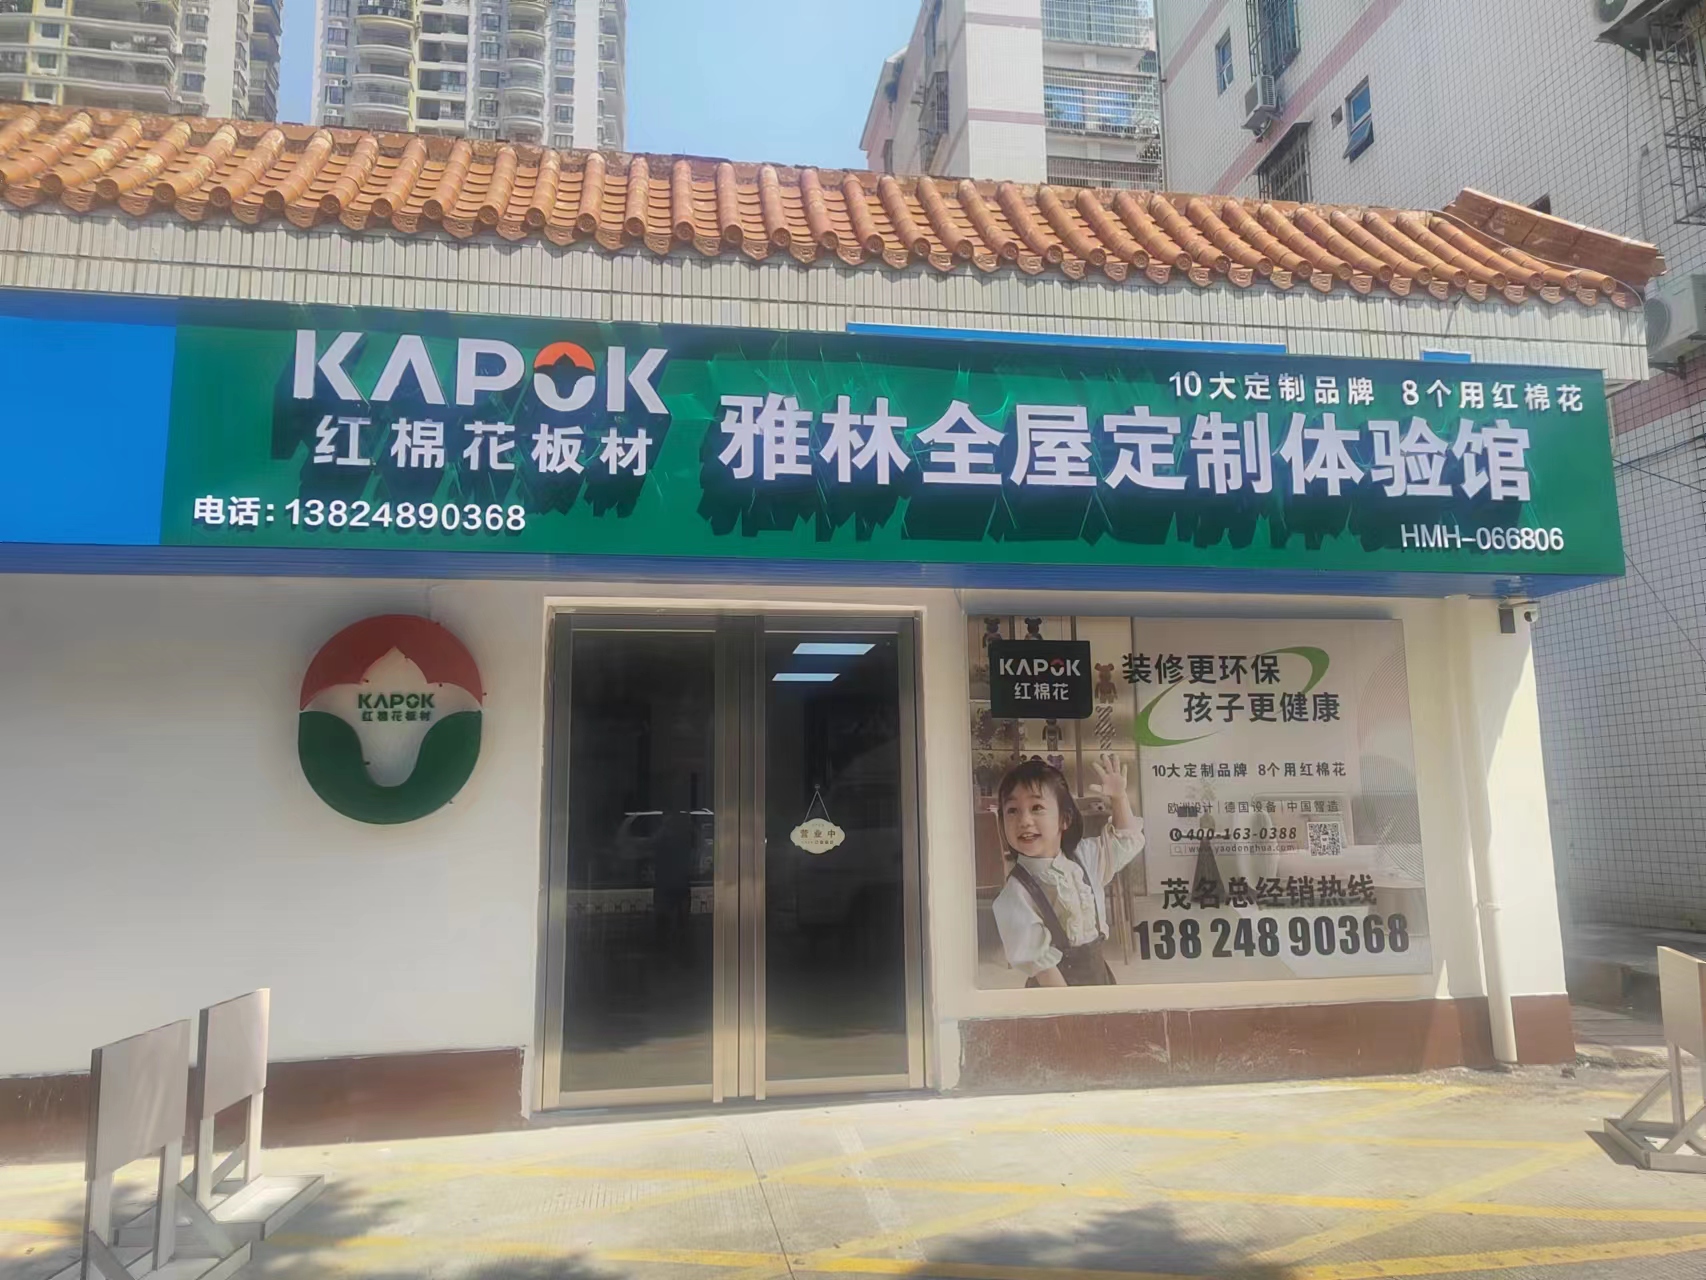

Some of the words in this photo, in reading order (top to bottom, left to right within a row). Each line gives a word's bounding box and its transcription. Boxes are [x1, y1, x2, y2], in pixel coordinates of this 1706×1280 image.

[293, 328, 671, 415] KAPOK
[1169, 370, 1375, 406] 10大定制品牌
[1402, 378, 1584, 412] 8个用红棉花
[313, 414, 653, 476] 红棉花板材
[717, 391, 1531, 502] 雅林全屋定制体验馆
[1401, 523, 1565, 552] HMH-066806
[999, 657, 1081, 677] KAPOK
[1121, 652, 1281, 685] 装修更环保
[357, 693, 435, 709] KAPOK
[1014, 682, 1069, 700] 红棉花
[1182, 691, 1341, 723] 孩子更健康
[1151, 763, 1248, 778] 10大定制品牌
[1258, 762, 1346, 777] 8个用红棉花
[1186, 827, 1297, 841] 400-163-0388
[1188, 844, 1295, 855] wwyaodonghua.com
[1160, 874, 1377, 910] 茂名总经销热线
